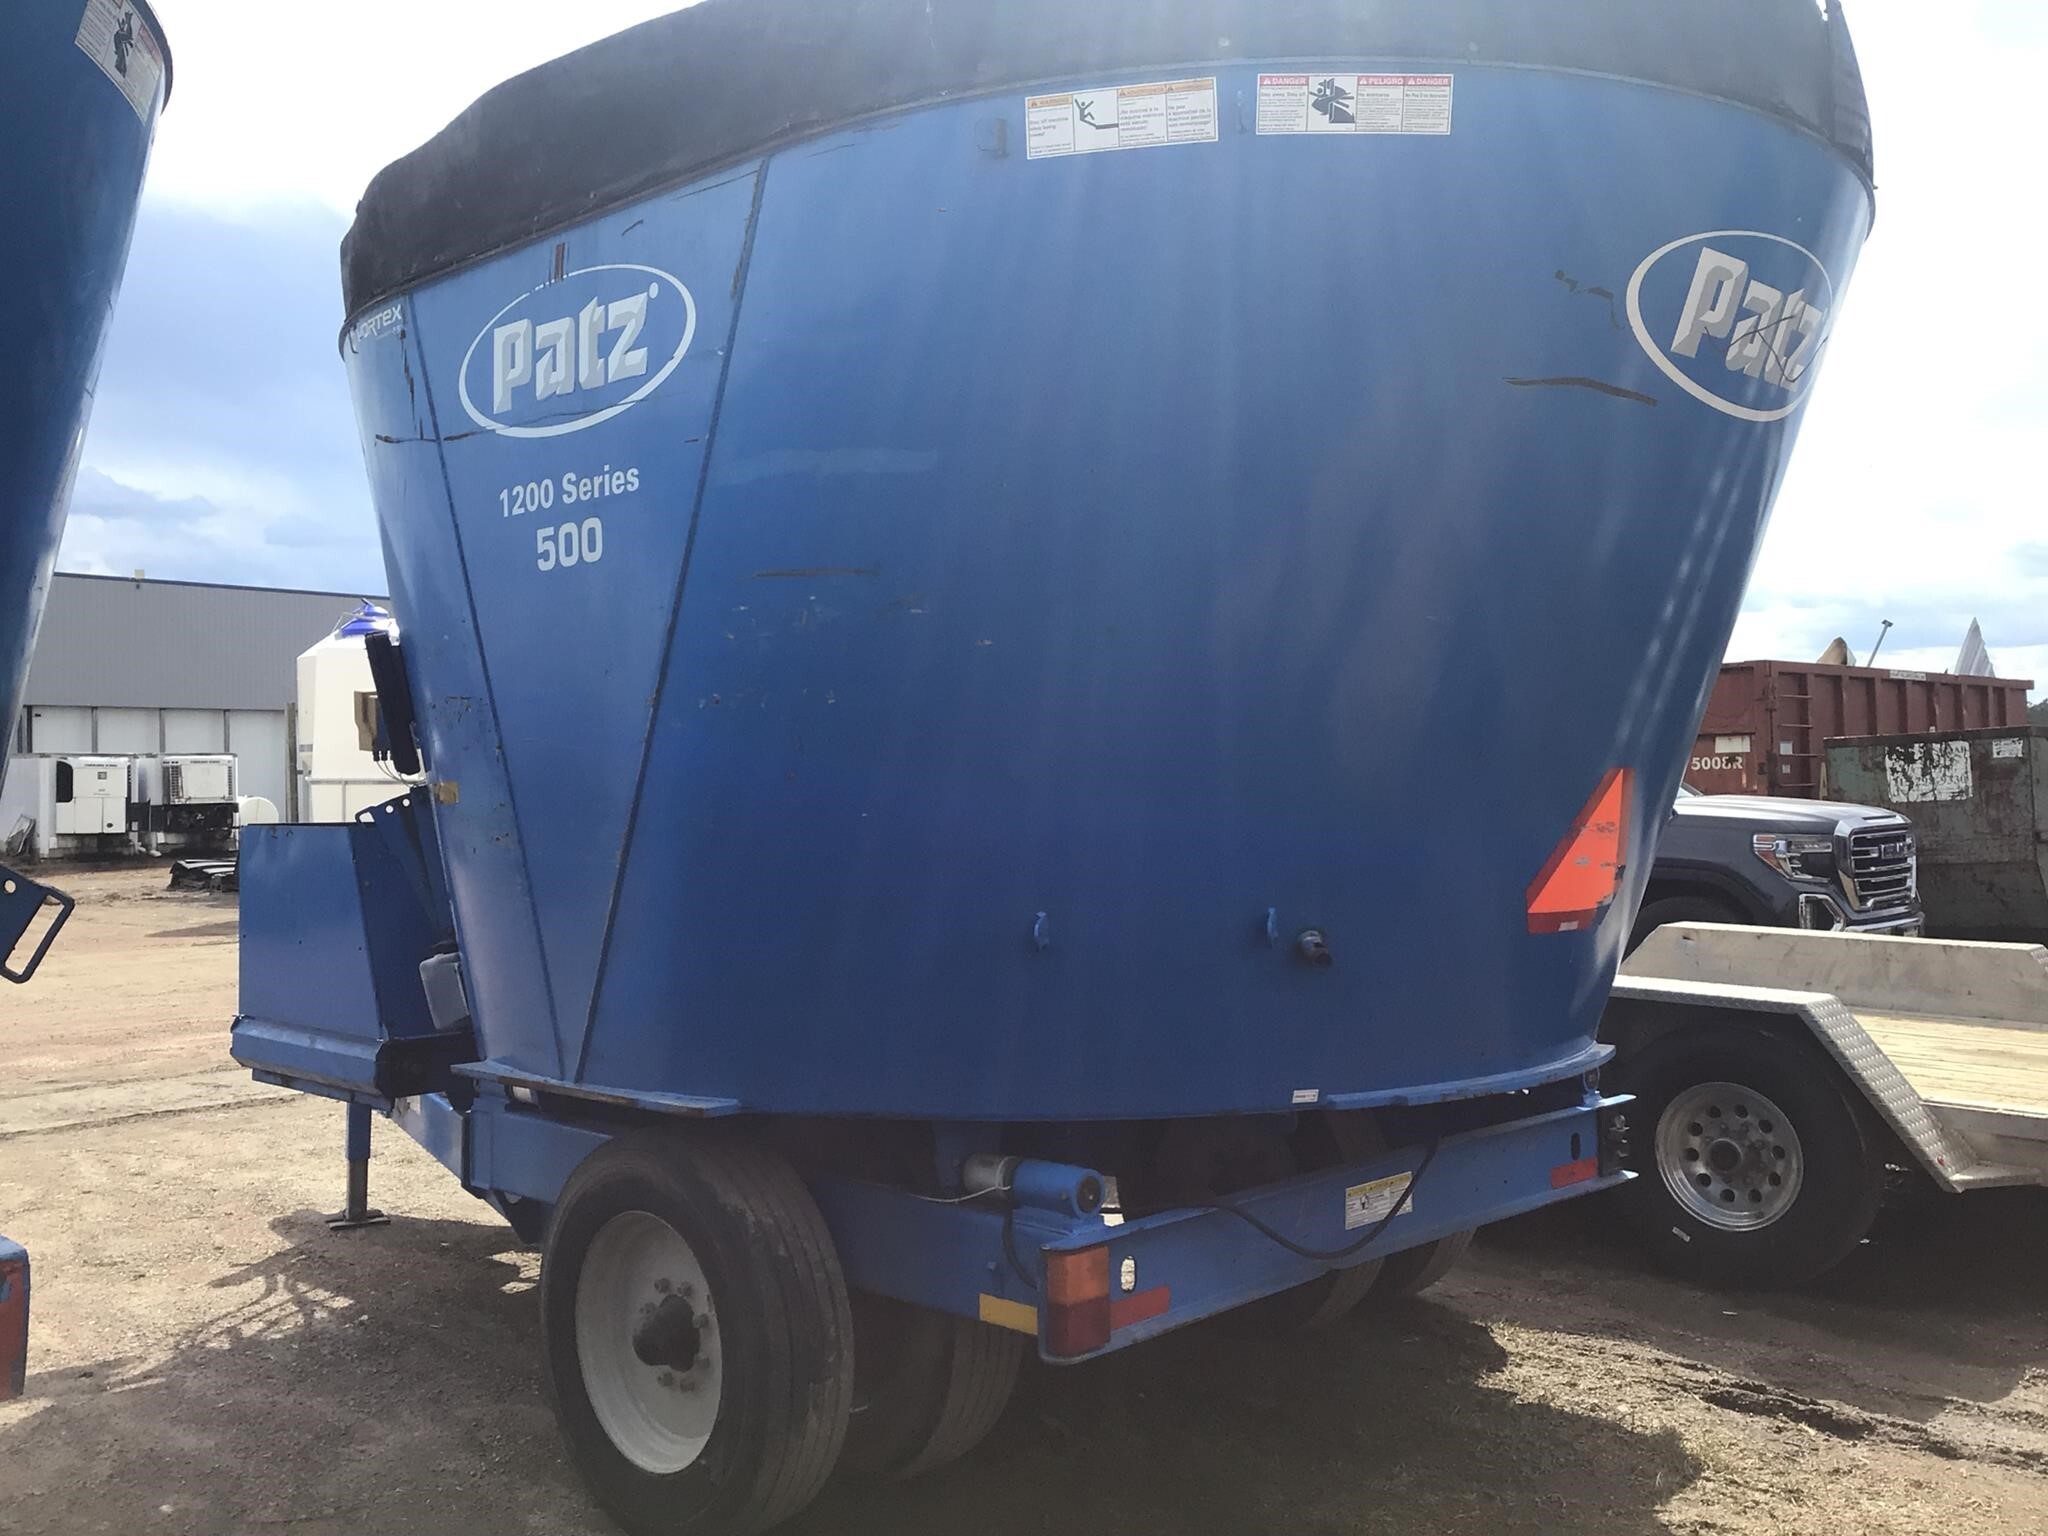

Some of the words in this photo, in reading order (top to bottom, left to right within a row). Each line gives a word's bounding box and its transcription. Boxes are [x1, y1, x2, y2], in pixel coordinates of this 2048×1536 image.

[1271, 77, 1306, 85] DANGER
[1368, 77, 1404, 85] PELIGRO
[1416, 77, 1449, 85] DANGER
[1670, 246, 1824, 392] Patz
[493, 289, 648, 414] Patz
[499, 476, 554, 517] 1200
[561, 464, 640, 504] Series
[536, 517, 603, 571] 500
